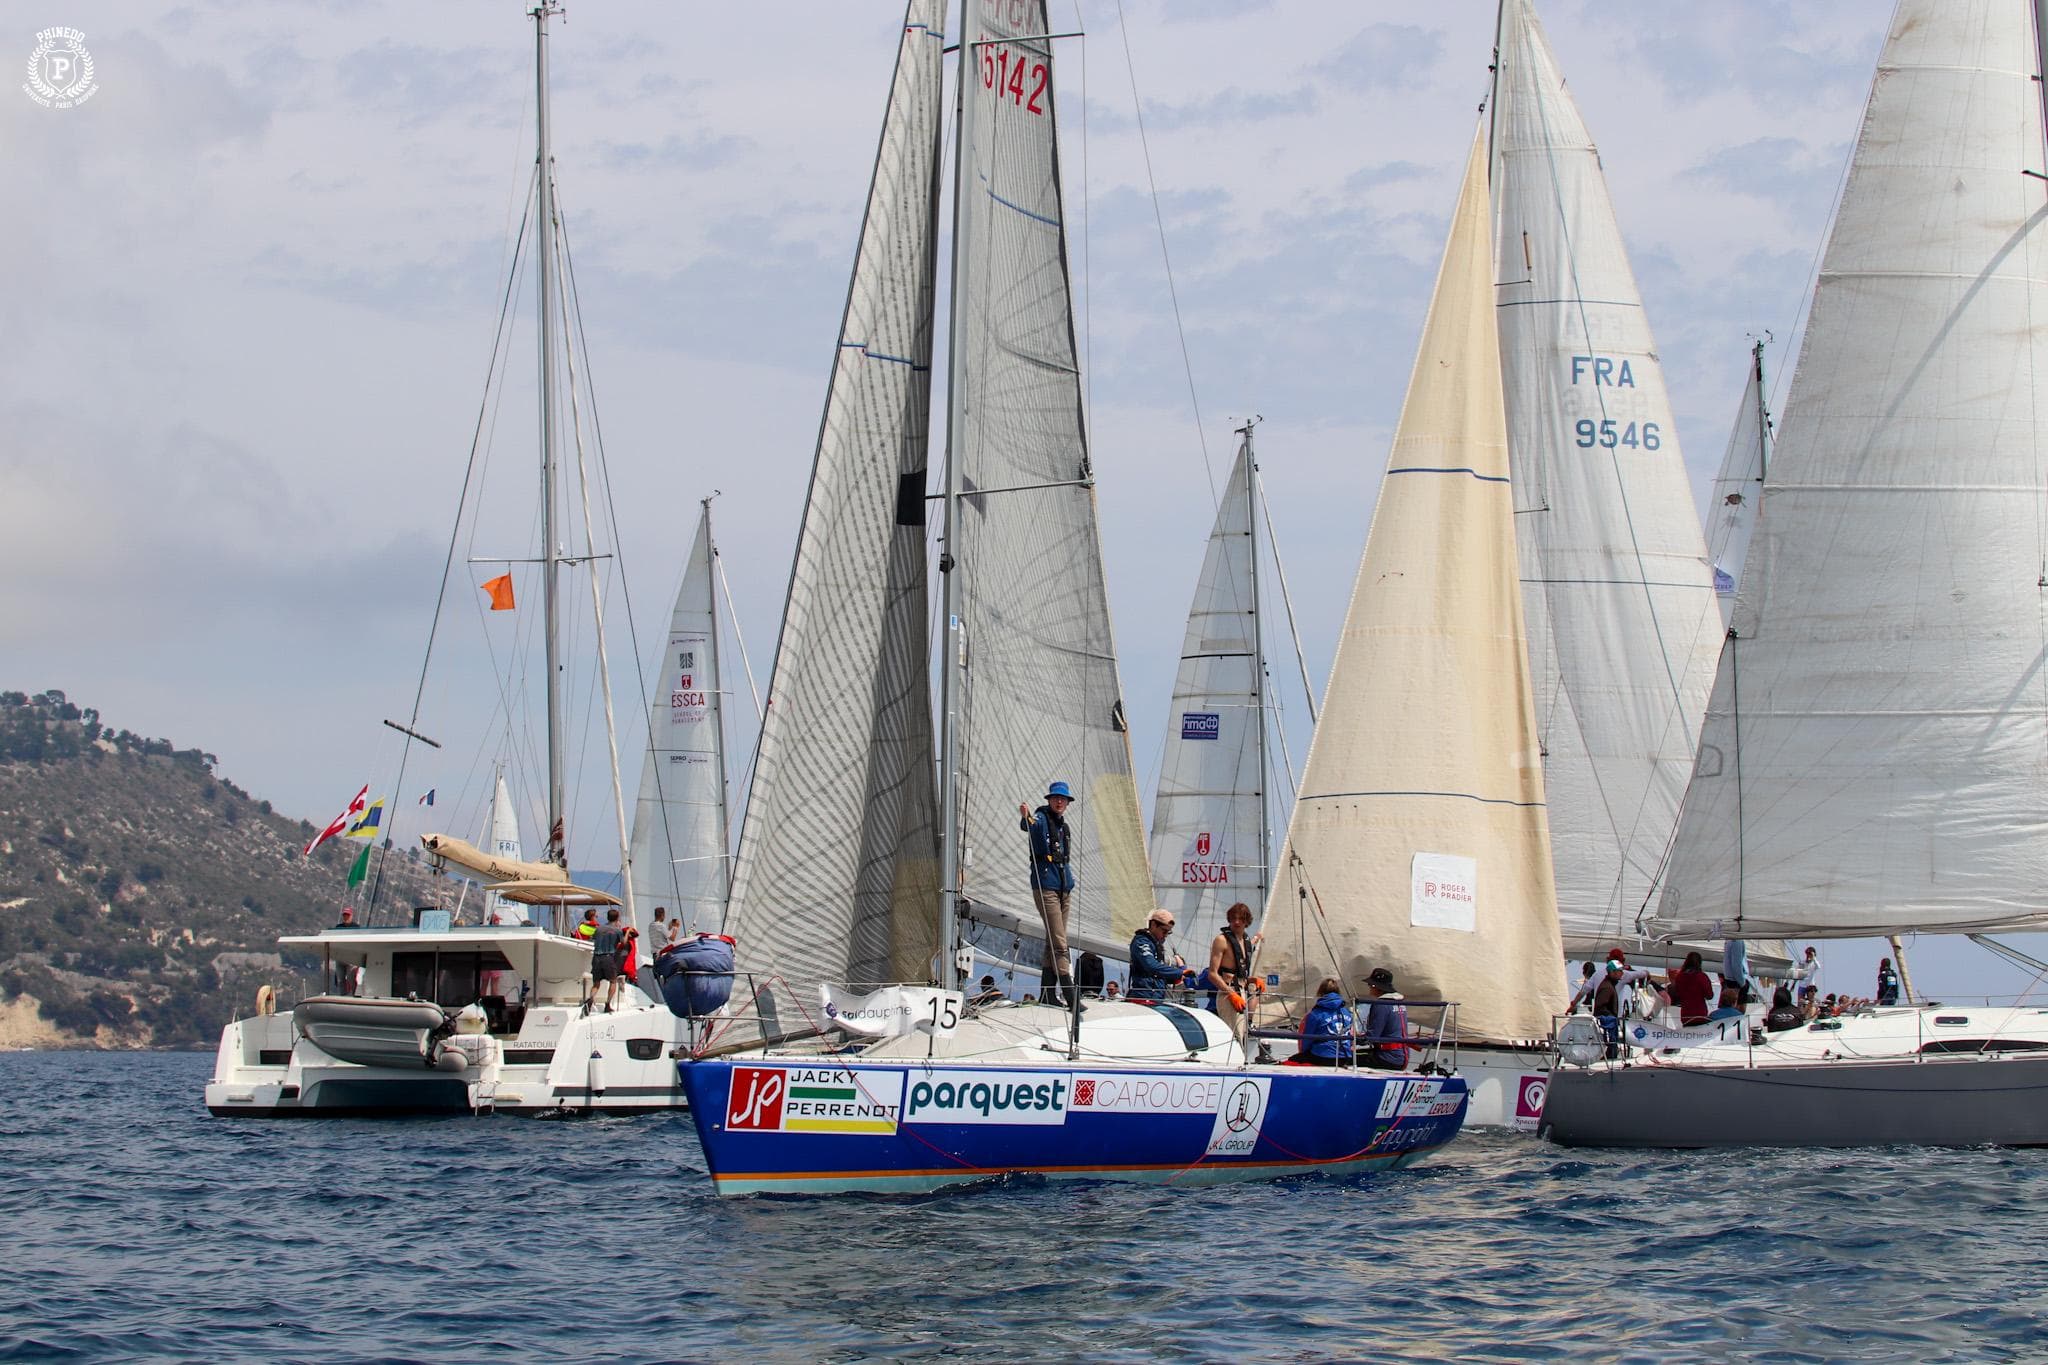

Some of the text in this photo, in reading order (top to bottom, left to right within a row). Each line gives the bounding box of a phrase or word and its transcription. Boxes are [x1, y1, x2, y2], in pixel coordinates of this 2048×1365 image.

[1571, 356, 1635, 388] FRA
[1575, 419, 1660, 451] 9546
[671, 693, 705, 708] ESSCA
[1182, 862, 1228, 883] ESSCA
[1440, 883, 1466, 893] ROGER
[1440, 892, 1472, 902] PRADIER
[928, 996, 958, 1030] 15
[1716, 1015, 1742, 1042] 11
[790, 1069, 859, 1084] JACKY
[908, 1079, 1066, 1117] parquest
[1096, 1080, 1219, 1109] CAROUGE
[786, 1102, 899, 1119] PERRENOT
[1225, 1139, 1255, 1151] GROUP
